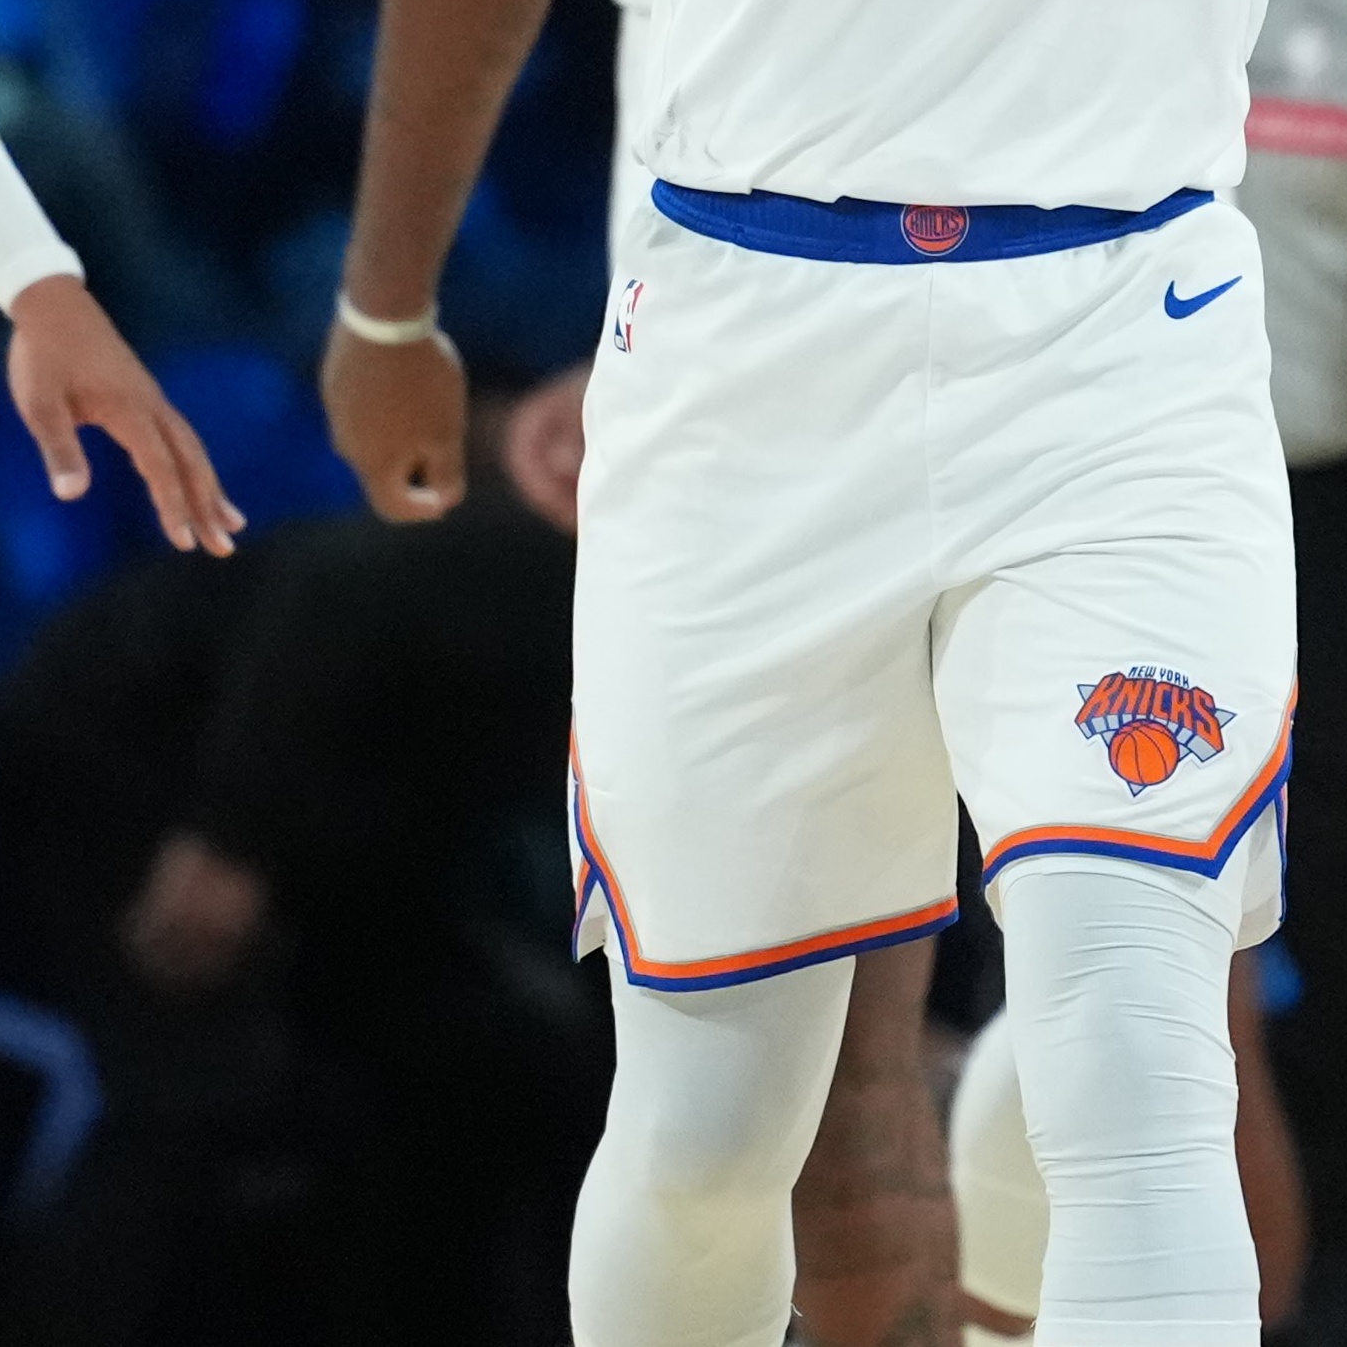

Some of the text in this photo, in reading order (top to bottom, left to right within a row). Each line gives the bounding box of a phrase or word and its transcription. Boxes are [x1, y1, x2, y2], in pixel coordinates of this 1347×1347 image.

[1128, 665, 1190, 689] NEW YORK
[1074, 671, 1225, 754] KNICKS
